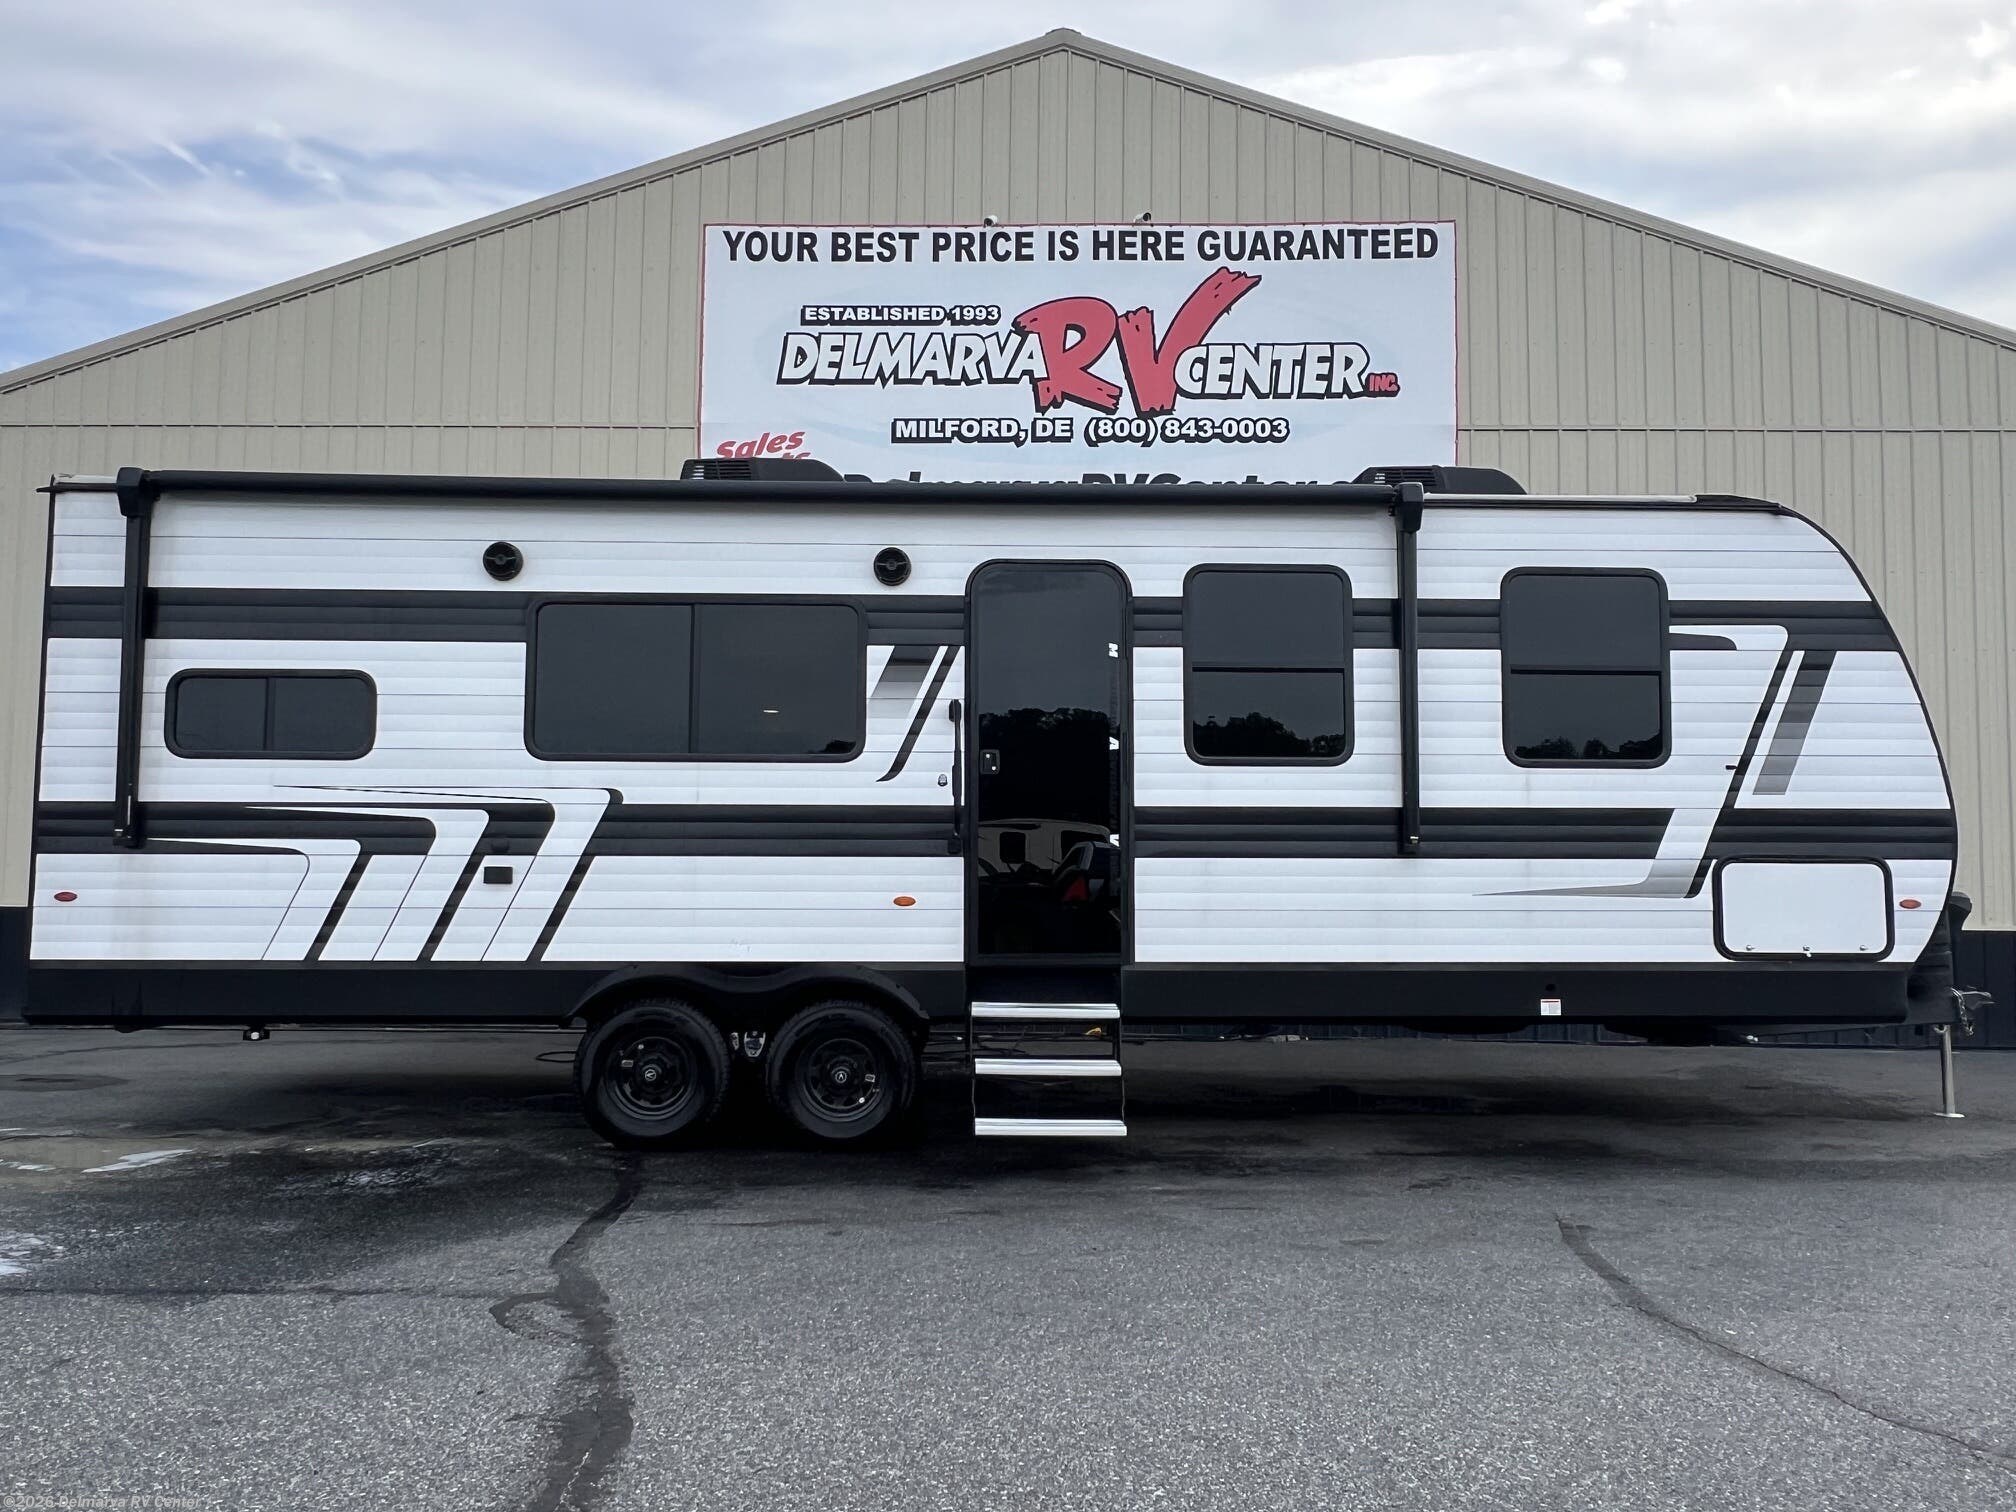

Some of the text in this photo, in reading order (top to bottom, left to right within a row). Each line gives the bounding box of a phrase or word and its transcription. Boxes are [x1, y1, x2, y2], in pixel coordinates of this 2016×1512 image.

[723, 228, 1438, 262] YOUR BEST PRICE IS HERE GUARANTEED
[802, 305, 1000, 326] ESTABLISHED 1993
[777, 331, 1050, 388] DELMARVA
[1011, 266, 1262, 417] RV
[1174, 342, 1370, 399] CENTER
[892, 417, 1290, 447] MILFORD, DE (800) 843-0003
